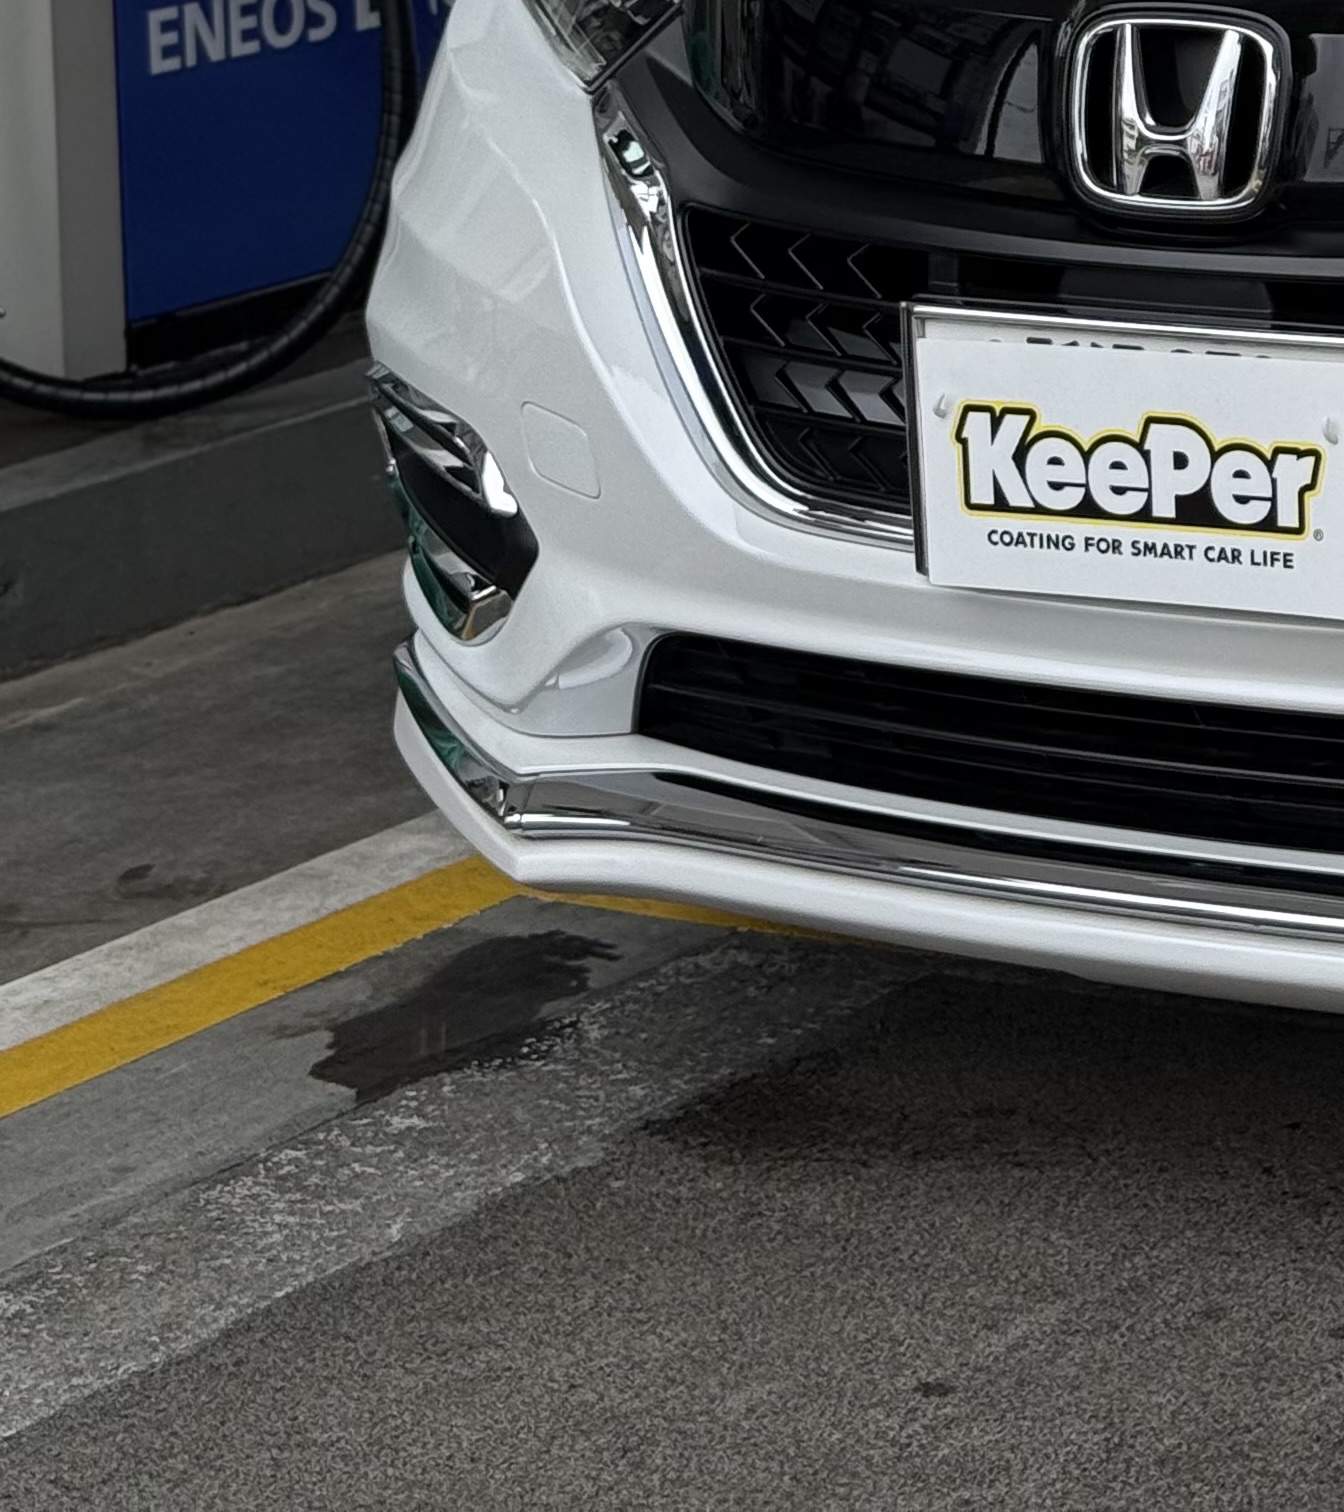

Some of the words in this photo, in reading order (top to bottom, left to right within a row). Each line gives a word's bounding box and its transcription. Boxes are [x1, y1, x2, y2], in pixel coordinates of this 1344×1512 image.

[955, 404, 1322, 535] KeePer
[987, 529, 1077, 552] COATING
[1084, 537, 1124, 556] FOR
[1130, 540, 1197, 562] SMART
[1203, 545, 1243, 566] CAR
[1250, 549, 1295, 569] LIFE
